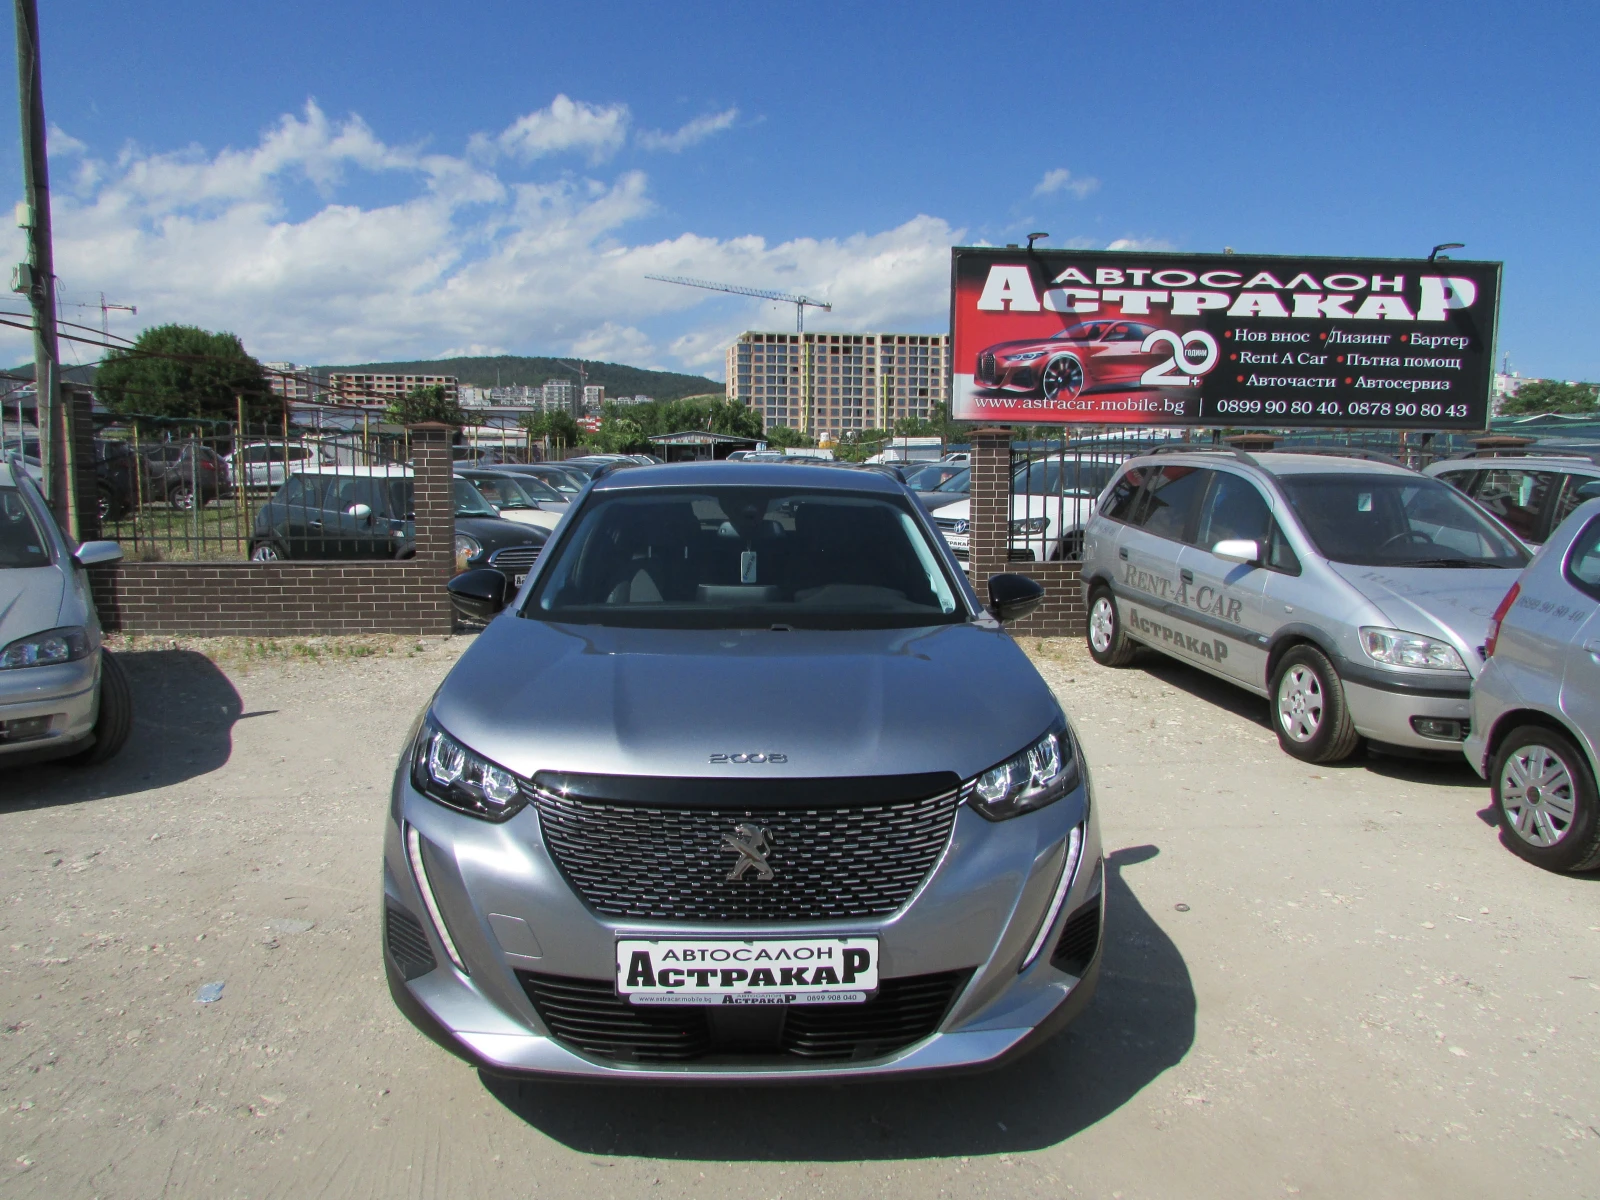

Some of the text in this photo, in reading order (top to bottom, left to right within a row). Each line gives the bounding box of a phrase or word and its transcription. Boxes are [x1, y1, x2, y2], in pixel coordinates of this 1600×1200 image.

[1051, 267, 1404, 292] АВТОСАЛОН
[976, 264, 1477, 321] АСТРАКАР
[1234, 328, 1310, 343] Нов внос
[1328, 330, 1391, 345] Лизинг
[1410, 332, 1469, 349] Бартер
[1239, 351, 1328, 365] Rent A Car
[1346, 353, 1462, 370] Пътна помощ
[1246, 374, 1337, 388] Авточасти
[1354, 376, 1450, 392] Автосервиз
[974, 397, 1185, 416] www.astracar.mobile.bg
[1217, 399, 1468, 418] 0899 90 80 40, 0878 90 80 43
[1123, 563, 1243, 624] RENT-A-CAR
[708, 753, 788, 764] 2008
[661, 946, 833, 962] АВТОСАЛОН
[626, 948, 871, 987] АСТРАКАР
